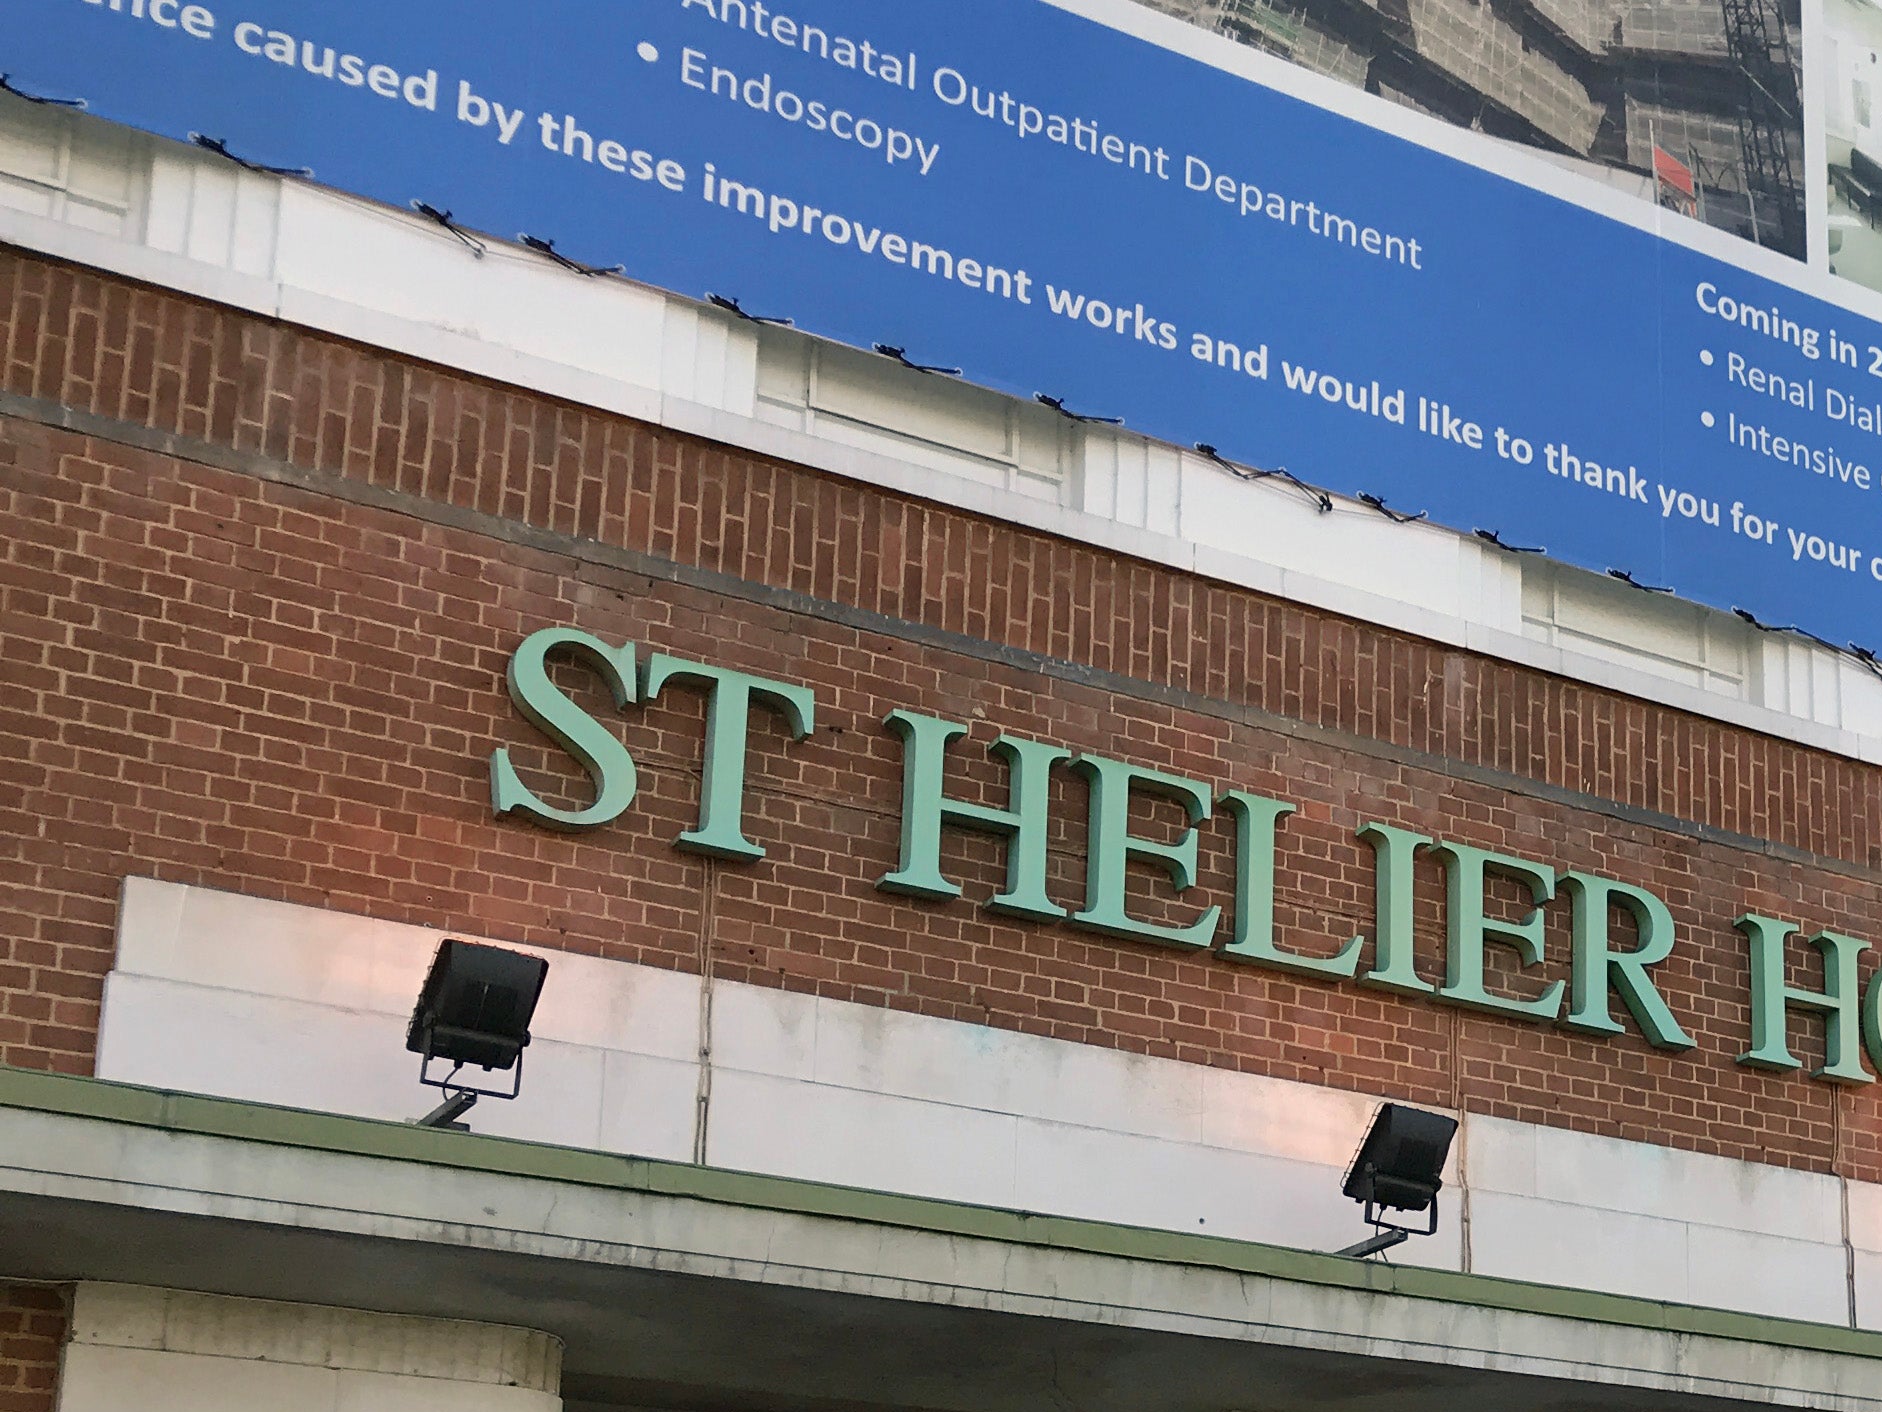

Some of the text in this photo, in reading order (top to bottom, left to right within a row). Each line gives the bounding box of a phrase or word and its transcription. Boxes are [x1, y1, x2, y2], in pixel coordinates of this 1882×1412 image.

[682, 47, 940, 175] Endoscopy
[934, 68, 1169, 179] Outpatient
[1186, 156, 1421, 269] Department
[235, 23, 437, 111] caused
[458, 80, 524, 144] by
[538, 113, 685, 191] these
[704, 163, 1031, 304] improvement
[1046, 285, 1177, 349] works
[1191, 334, 1267, 380] and
[1282, 362, 1404, 424] would
[1420, 397, 1482, 448] like
[1495, 427, 1532, 464] to
[1544, 444, 1648, 503] thank
[1658, 485, 1719, 526] you
[1730, 502, 1778, 544] for
[1788, 528, 1861, 571] your
[1697, 281, 1820, 360] Coming
[1830, 330, 1857, 367] in
[1729, 352, 1813, 410] Renal
[1730, 412, 1871, 489] Intensive
[489, 627, 815, 862] ST
[874, 708, 1697, 1052] HELIER
